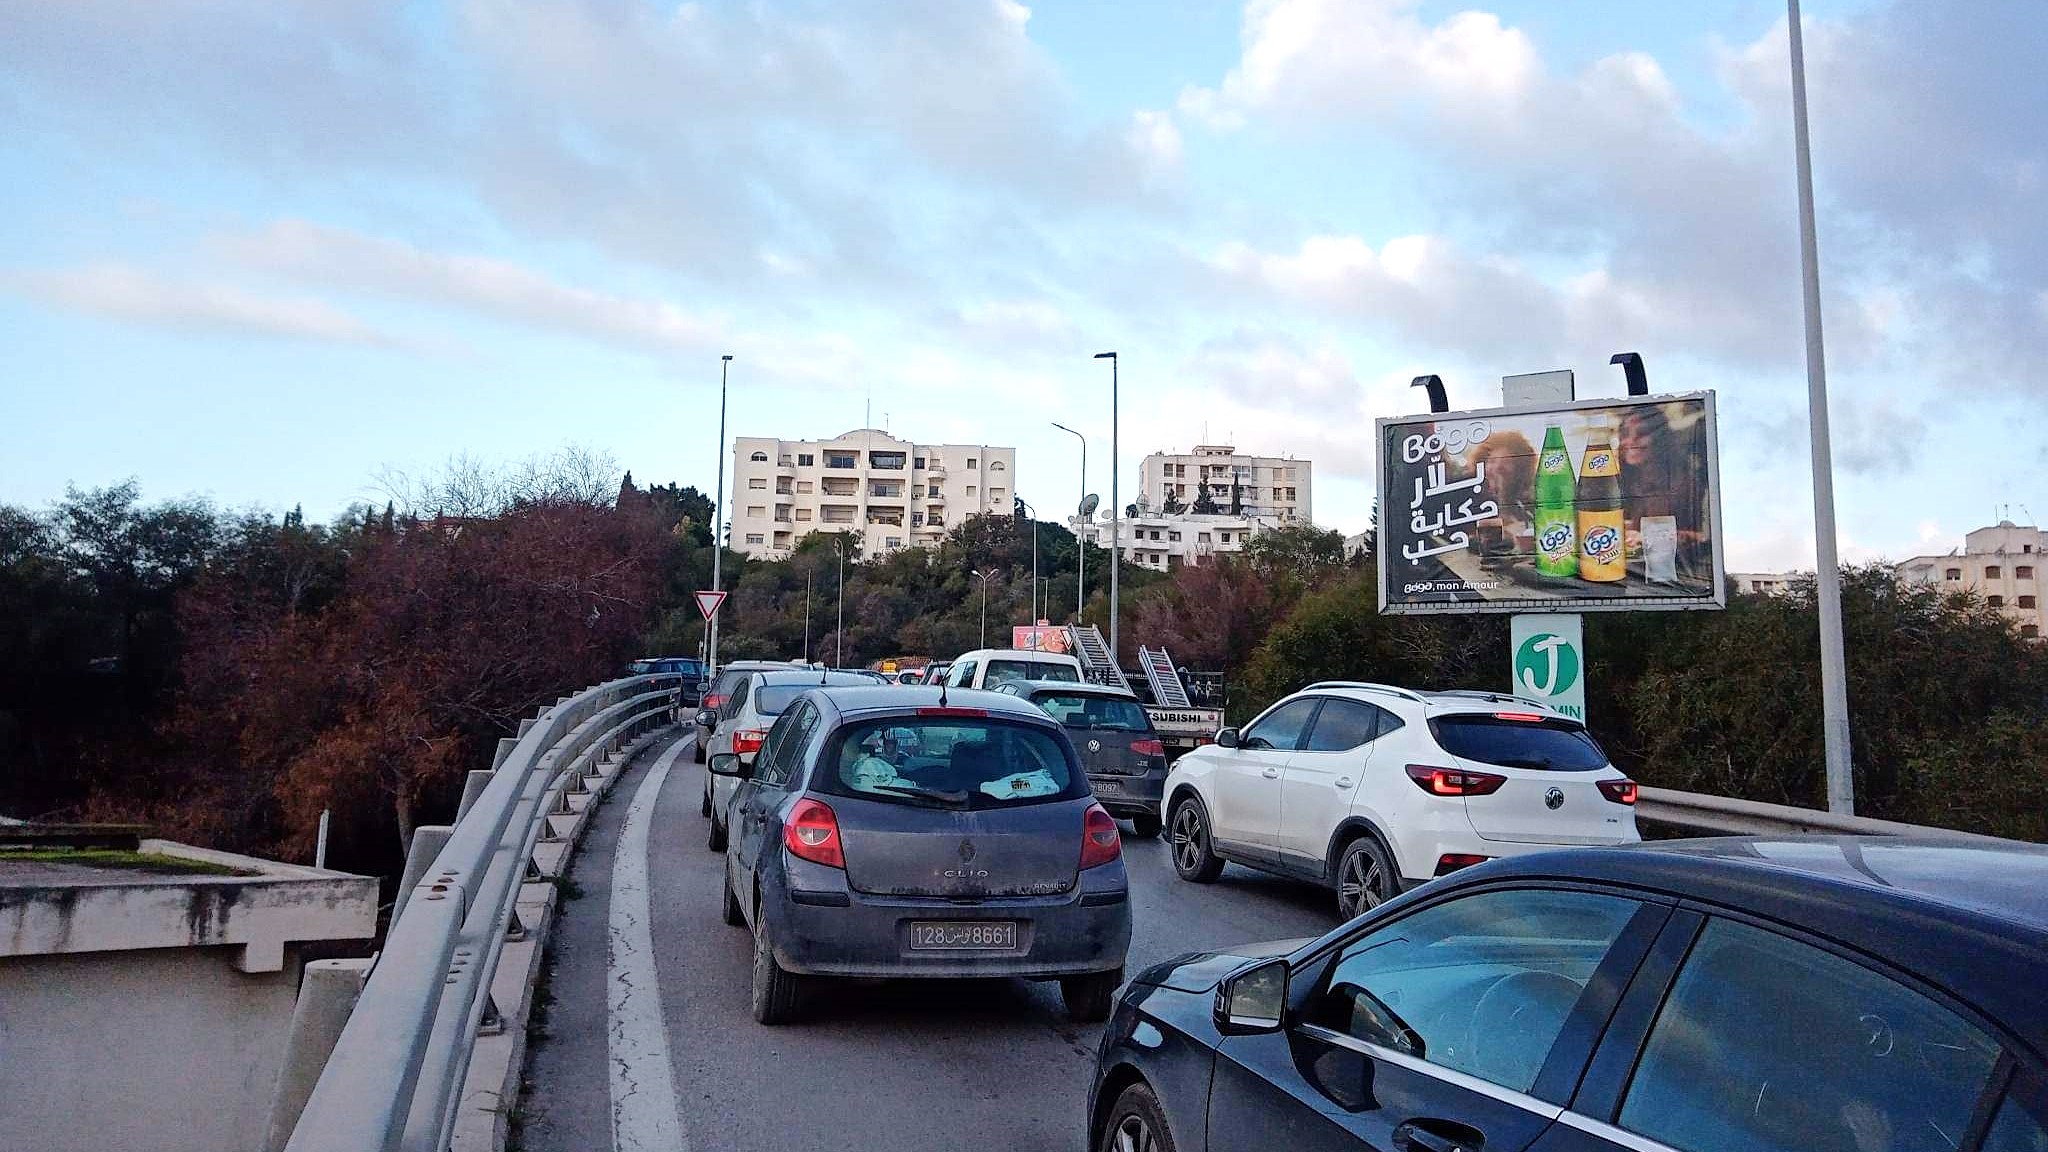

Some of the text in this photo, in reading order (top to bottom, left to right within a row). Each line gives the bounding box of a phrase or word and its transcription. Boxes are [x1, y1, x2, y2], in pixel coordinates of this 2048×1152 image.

[1402, 419, 1491, 464] Boga
[1410, 498, 1498, 537] حكاية
[1402, 531, 1469, 566] حب
[1436, 583, 1459, 591] mon
[1462, 581, 1500, 591] Amour
[1523, 635, 1568, 697] J
[1149, 712, 1201, 723] SUBISHI
[916, 926, 945, 944] 128
[972, 926, 1011, 944] 8661
